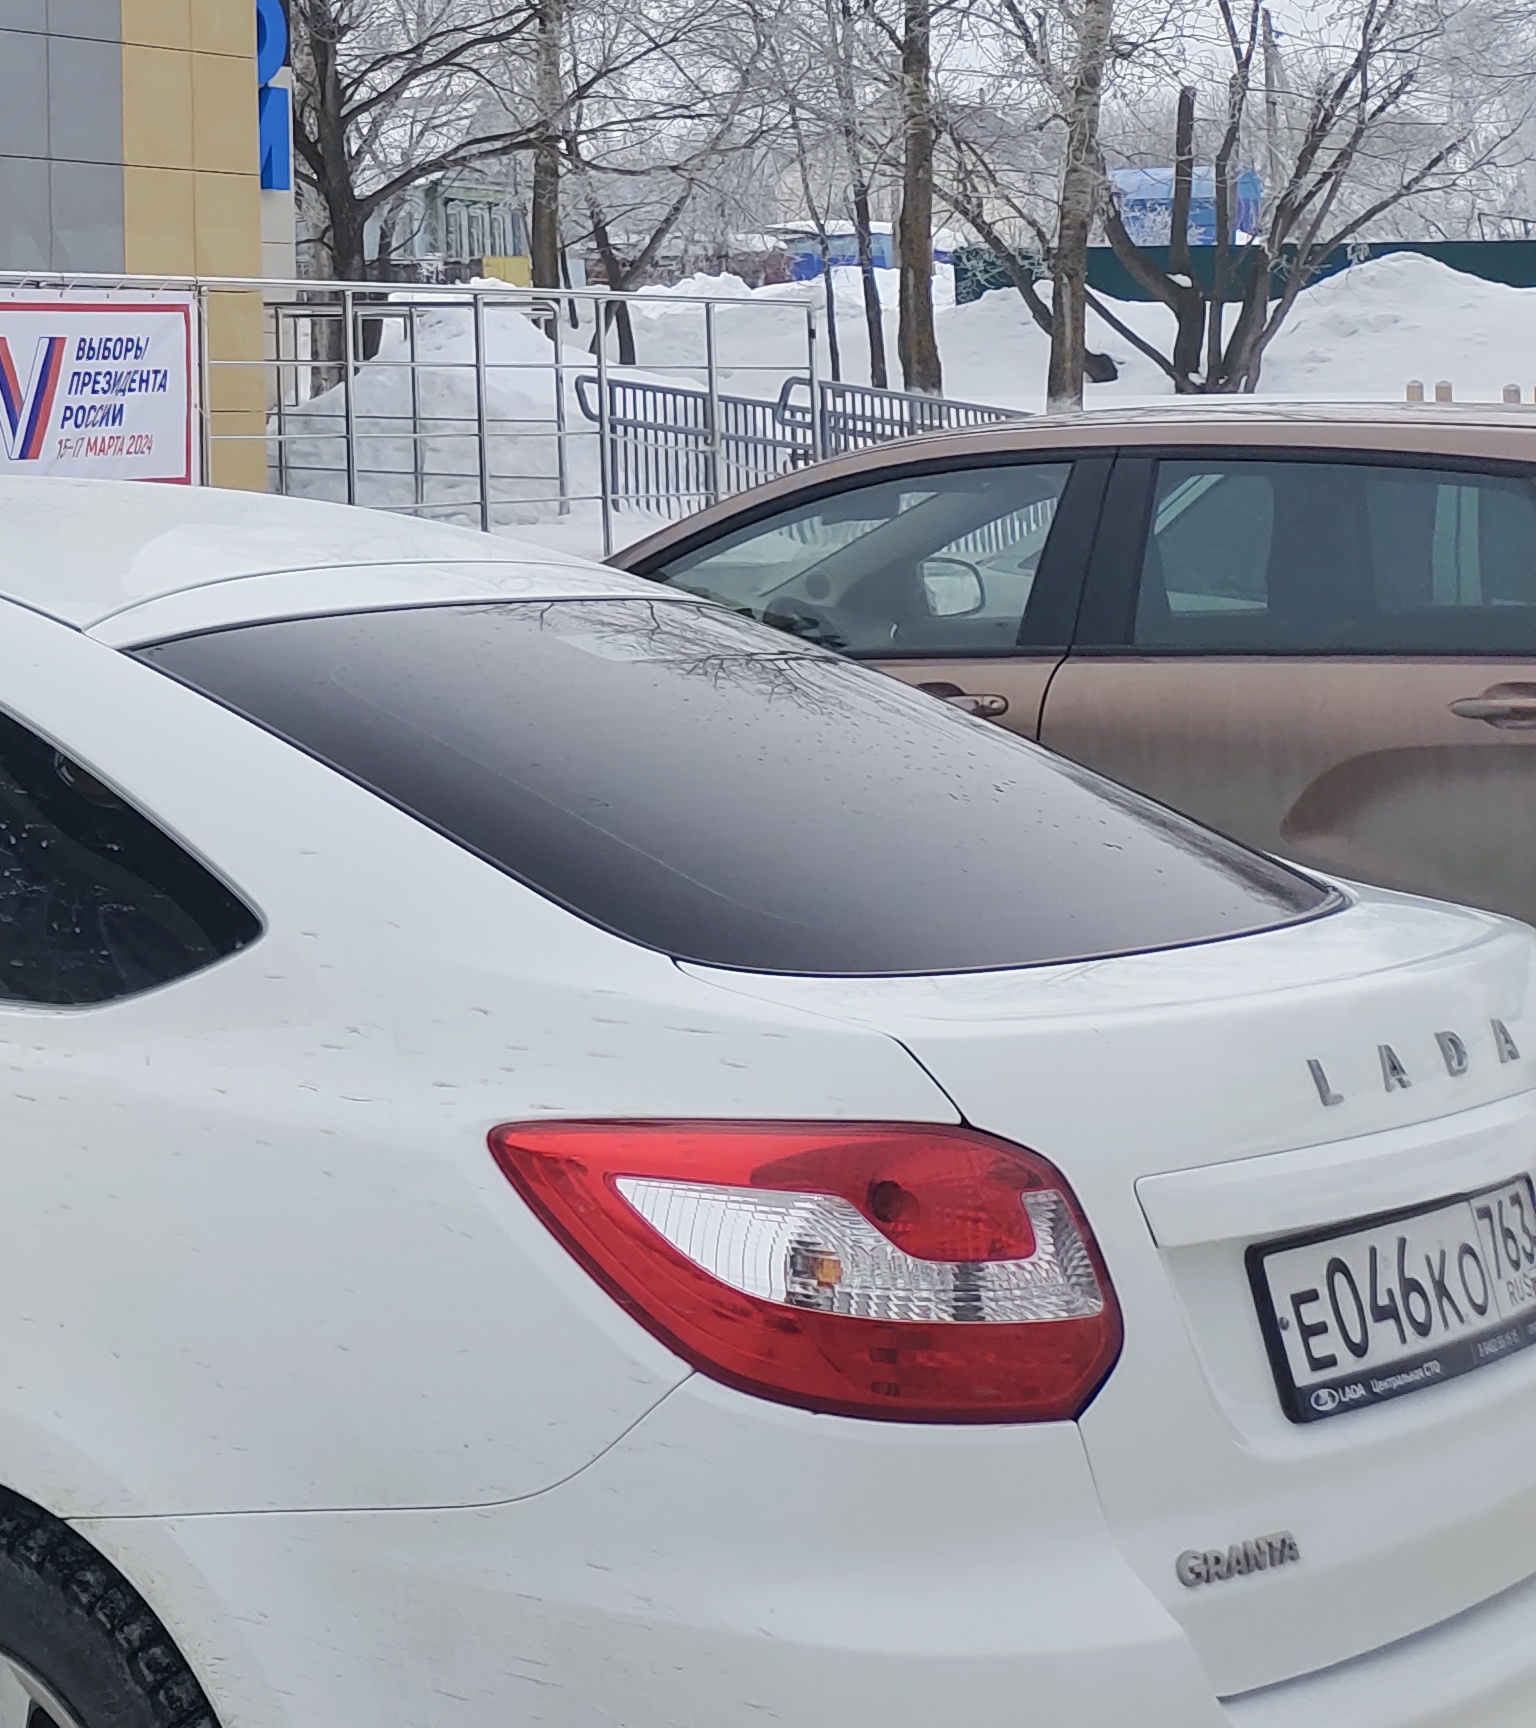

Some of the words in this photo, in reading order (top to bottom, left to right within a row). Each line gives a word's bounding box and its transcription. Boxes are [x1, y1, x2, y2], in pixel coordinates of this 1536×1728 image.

[76, 336, 150, 361] ВЫБОРЫ
[68, 369, 168, 396] ПРЕЗИДЕНТА
[60, 403, 124, 429] РОССИИ
[1306, 1017, 1520, 1107] LADA
[1290, 1236, 1489, 1371] Е046КО
[1476, 1191, 1536, 1279] 763
[1338, 1383, 1366, 1402] LADA
[1176, 1530, 1301, 1587] GRANTA
